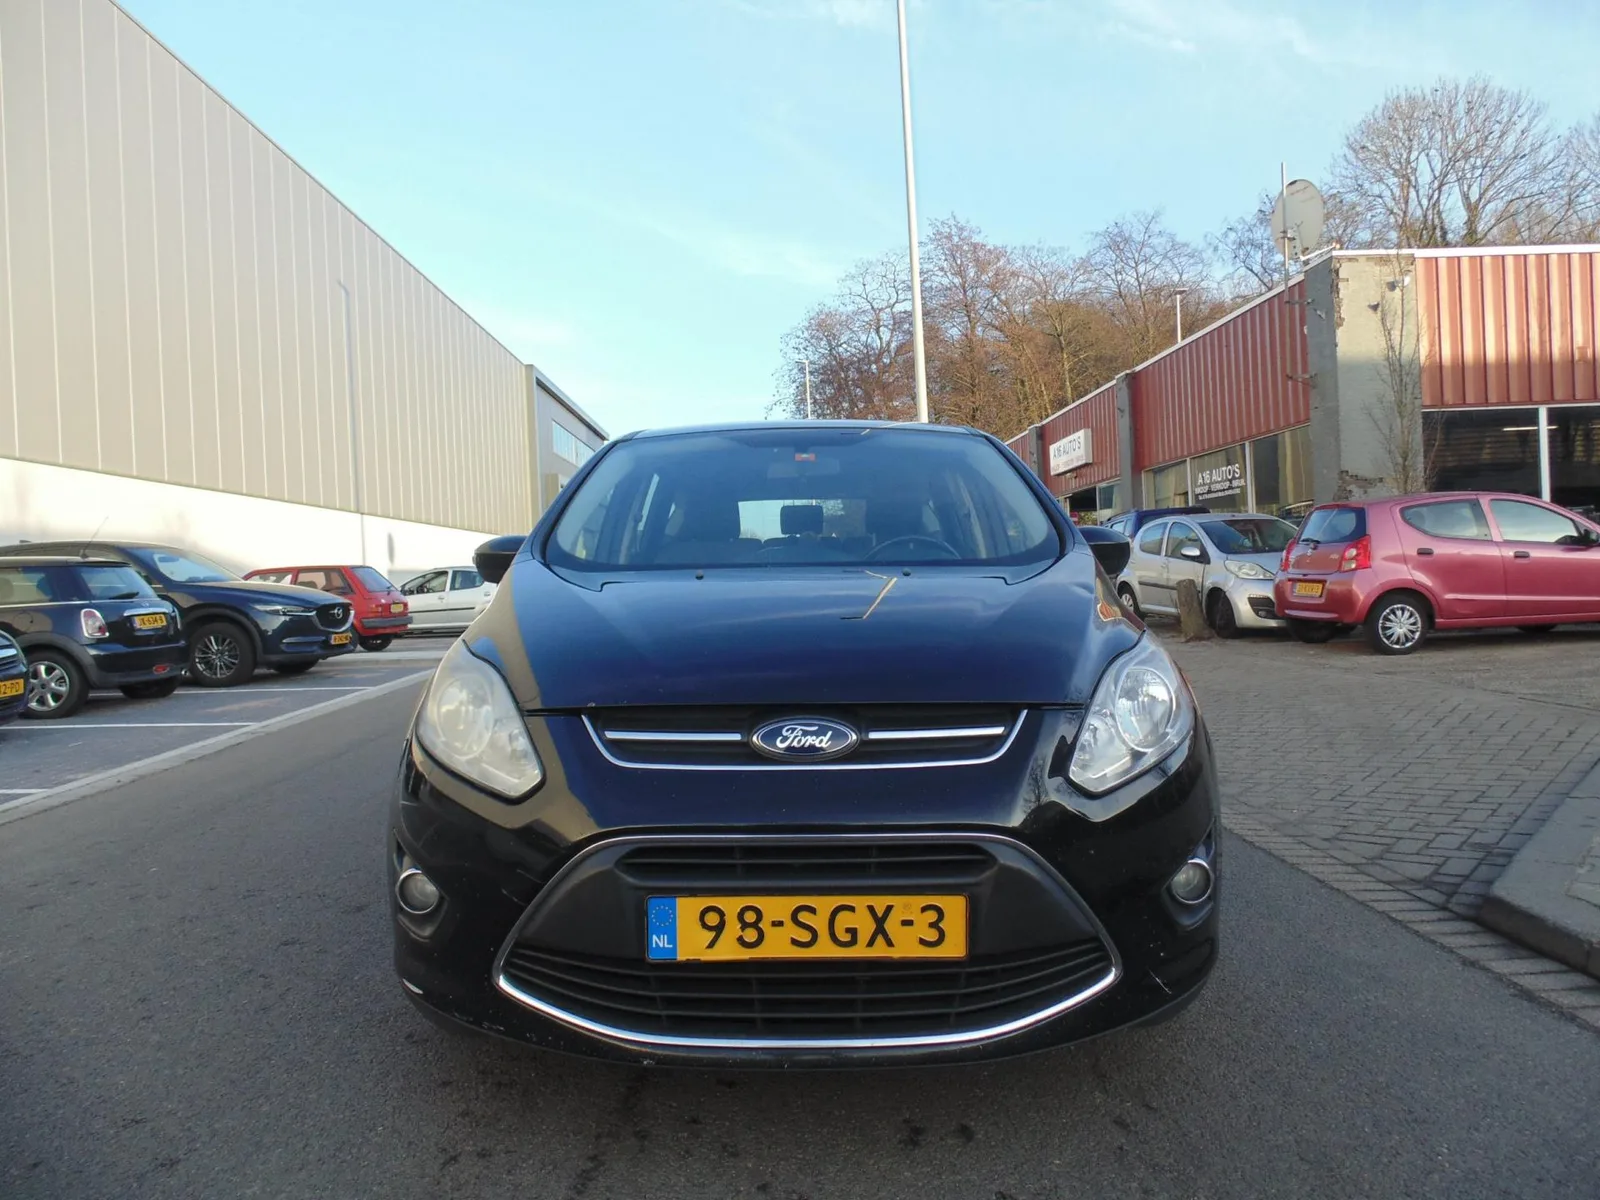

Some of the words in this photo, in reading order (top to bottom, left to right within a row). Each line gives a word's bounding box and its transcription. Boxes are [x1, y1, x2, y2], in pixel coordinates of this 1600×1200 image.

[1053, 444, 1062, 460] A16
[1062, 435, 1082, 456] AUTO'S
[1197, 470, 1211, 486] A16
[1211, 463, 1241, 482] AUTO'S
[0, 681, 20, 696] 2-PD
[776, 725, 833, 748] Ford
[698, 903, 947, 950] 98-SGX-3
[651, 934, 673, 949] NL
